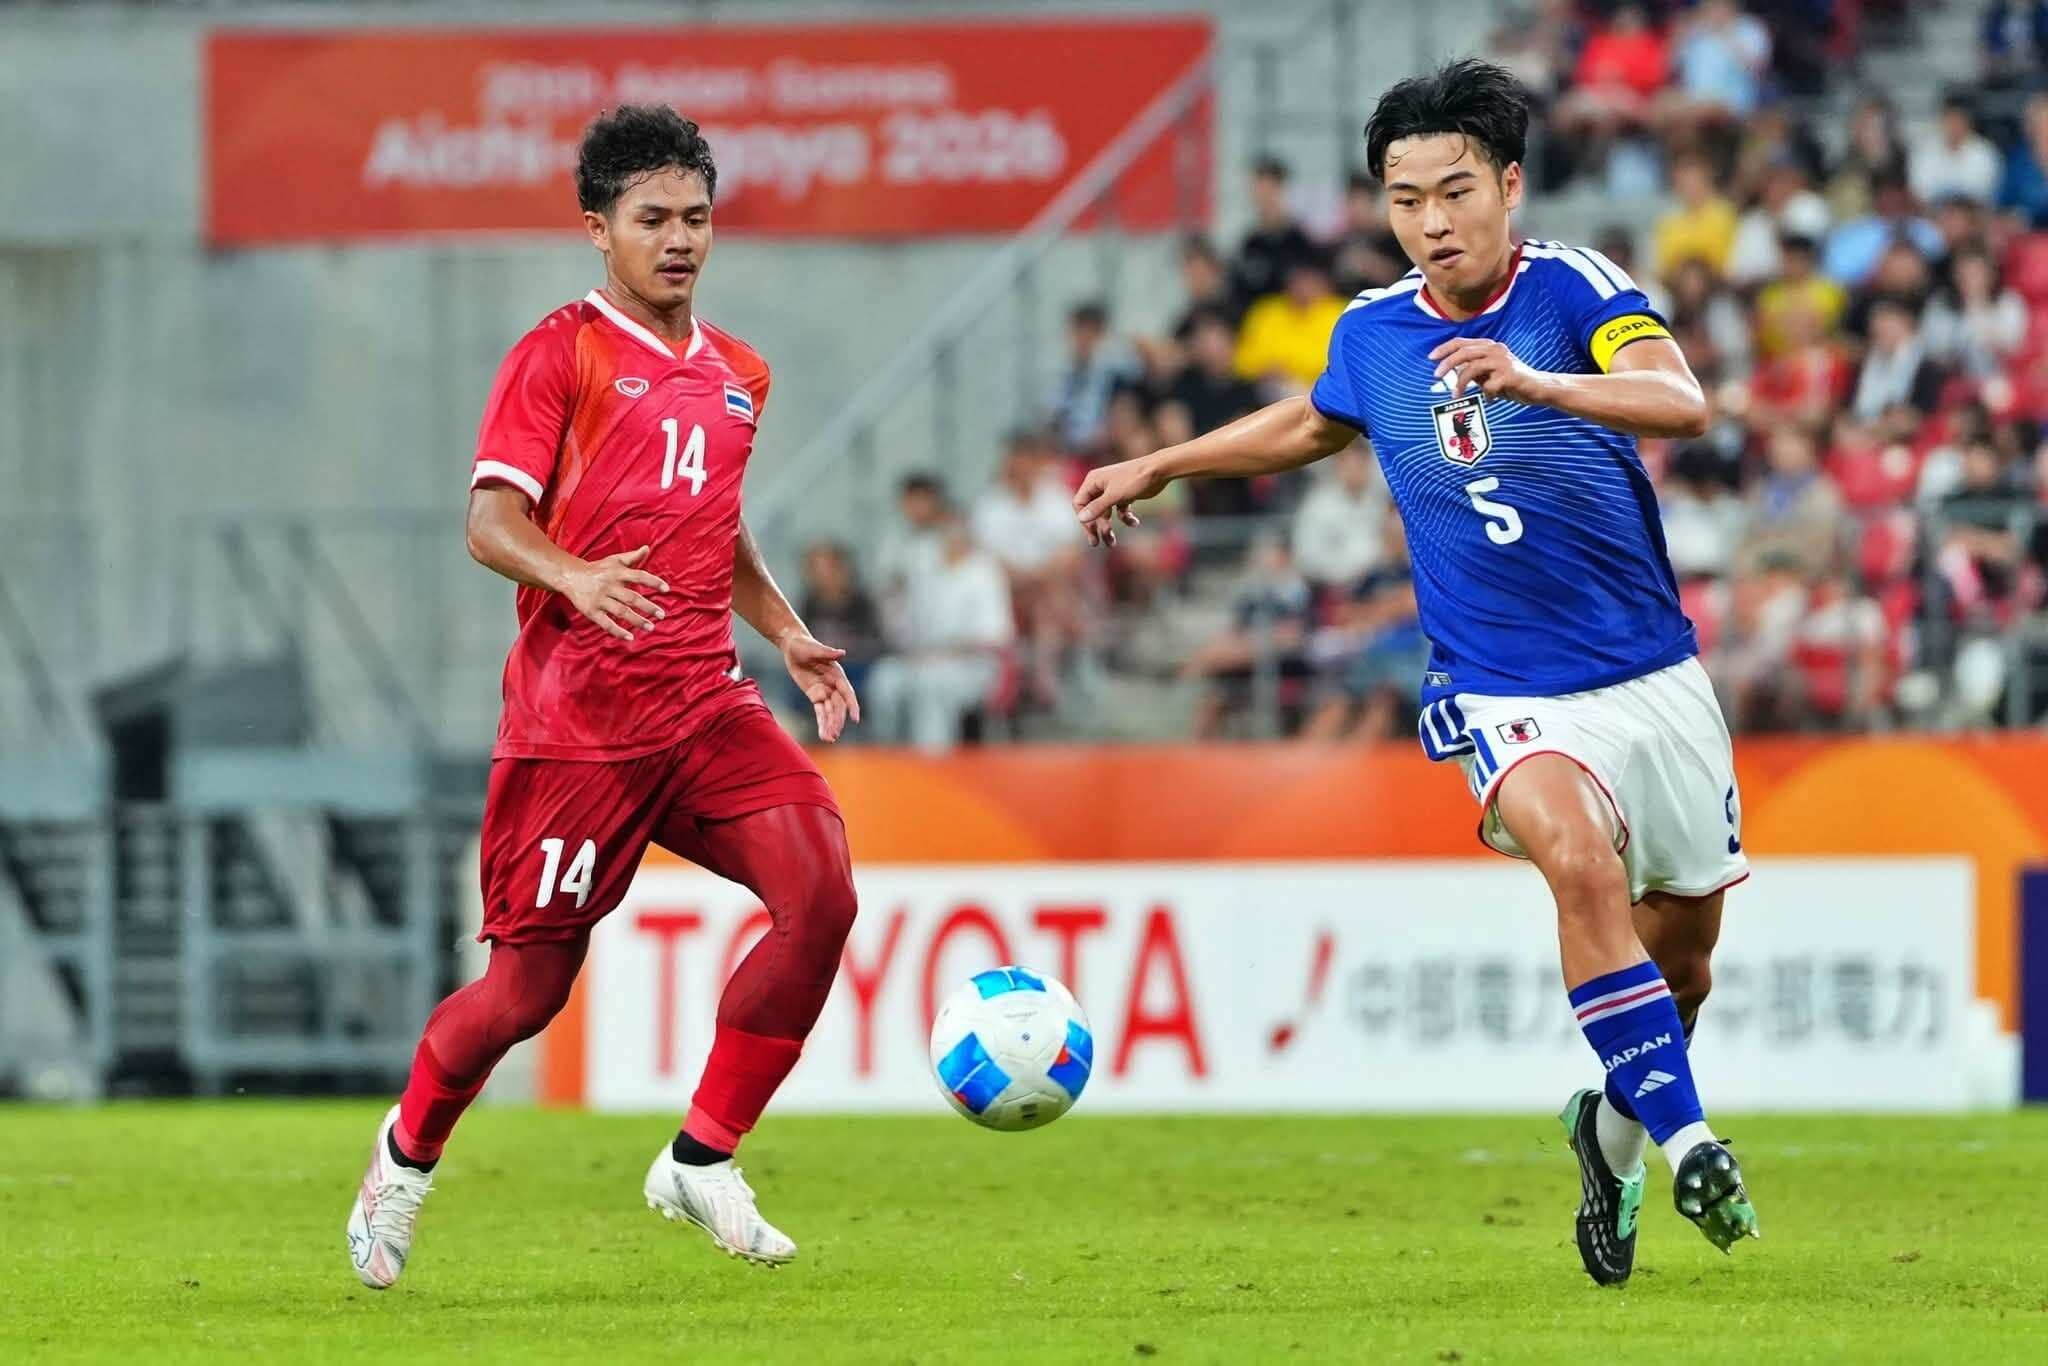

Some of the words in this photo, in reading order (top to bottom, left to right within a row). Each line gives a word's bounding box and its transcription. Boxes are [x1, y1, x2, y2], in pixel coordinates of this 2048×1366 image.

[364, 118, 868, 194] Aichi-goya
[884, 112, 1067, 181] 2026
[661, 418, 707, 496] 14
[1465, 477, 1523, 545] 5
[536, 838, 596, 909] 14
[1605, 1032, 1672, 1073] JAPAN
